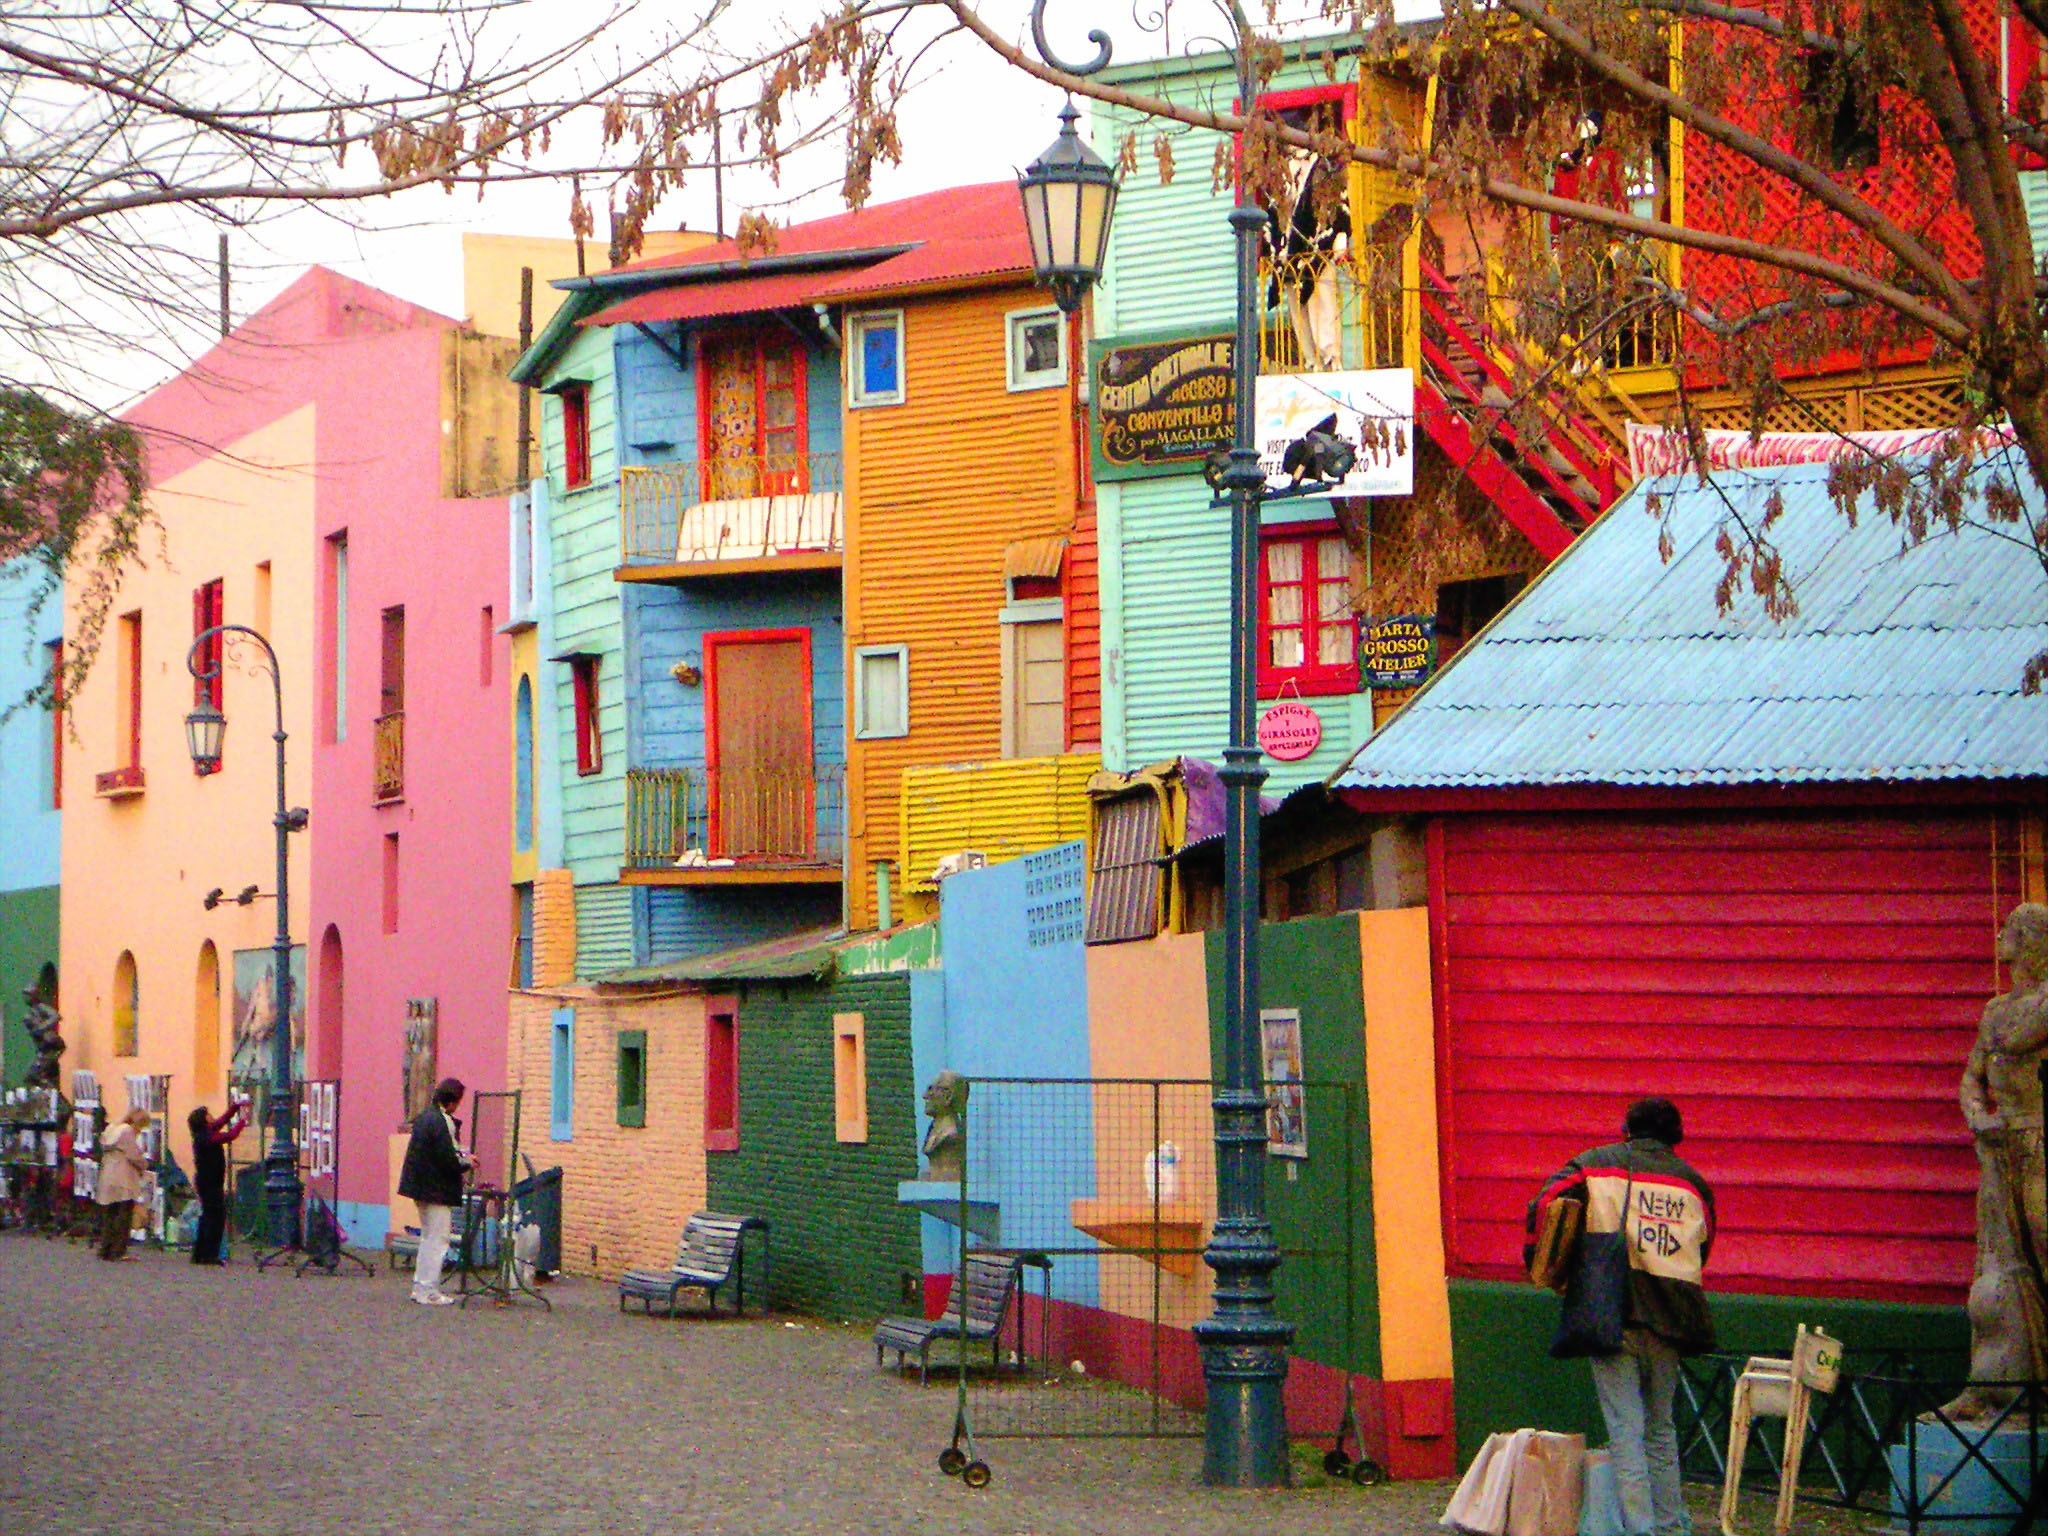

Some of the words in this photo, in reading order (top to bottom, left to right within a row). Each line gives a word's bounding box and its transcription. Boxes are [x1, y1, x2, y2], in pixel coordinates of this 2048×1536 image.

[1166, 374, 1227, 403] ACCESO
[1127, 402, 1223, 433] CONVENTILLO
[1157, 423, 1237, 445] MAGALLAN
[1369, 623, 1422, 641] MARTA
[1363, 637, 1430, 656] GROSSO
[1366, 653, 1428, 671] ATELIER
[1265, 705, 1312, 722] ESPIGAS
[1260, 727, 1318, 740] GIRASOLES
[1639, 1190, 1685, 1219] NEW
